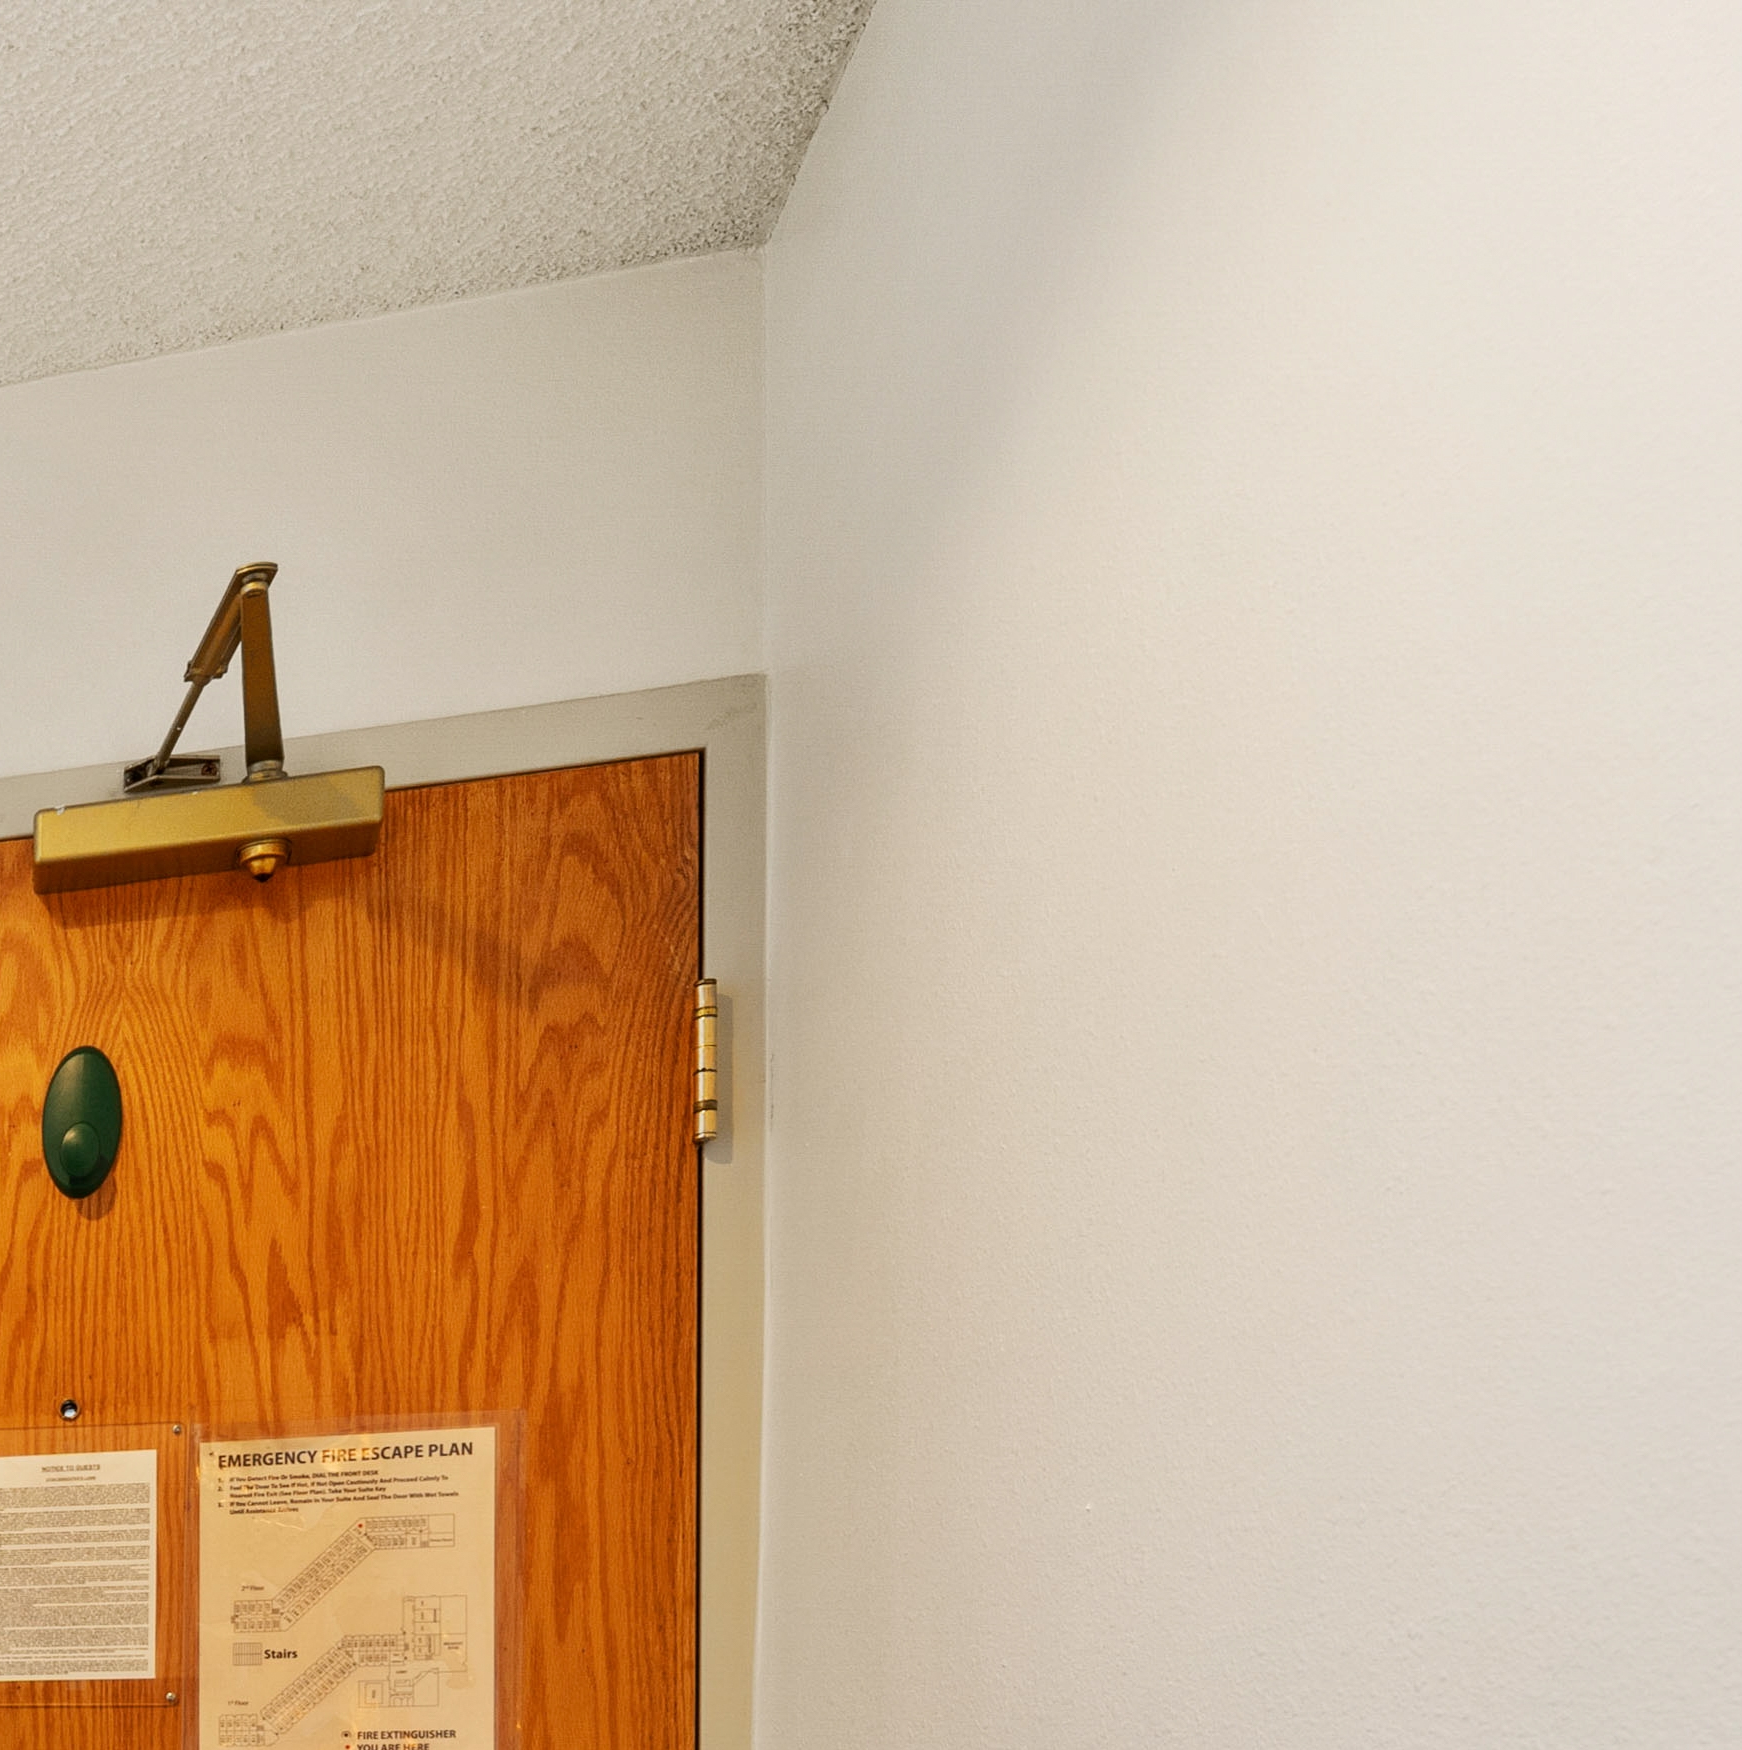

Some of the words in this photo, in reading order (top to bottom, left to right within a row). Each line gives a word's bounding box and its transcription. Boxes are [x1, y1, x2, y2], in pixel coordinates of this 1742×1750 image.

[218, 1450, 318, 1468] EMERGENCY
[321, 1448, 357, 1463] FIRE
[361, 1445, 424, 1461] ESCAPE
[428, 1442, 473, 1457] PLAN
[264, 1648, 298, 1659] Stairs
[357, 1731, 378, 1740] FIRE
[380, 1730, 457, 1740] EXTINGUISHER
